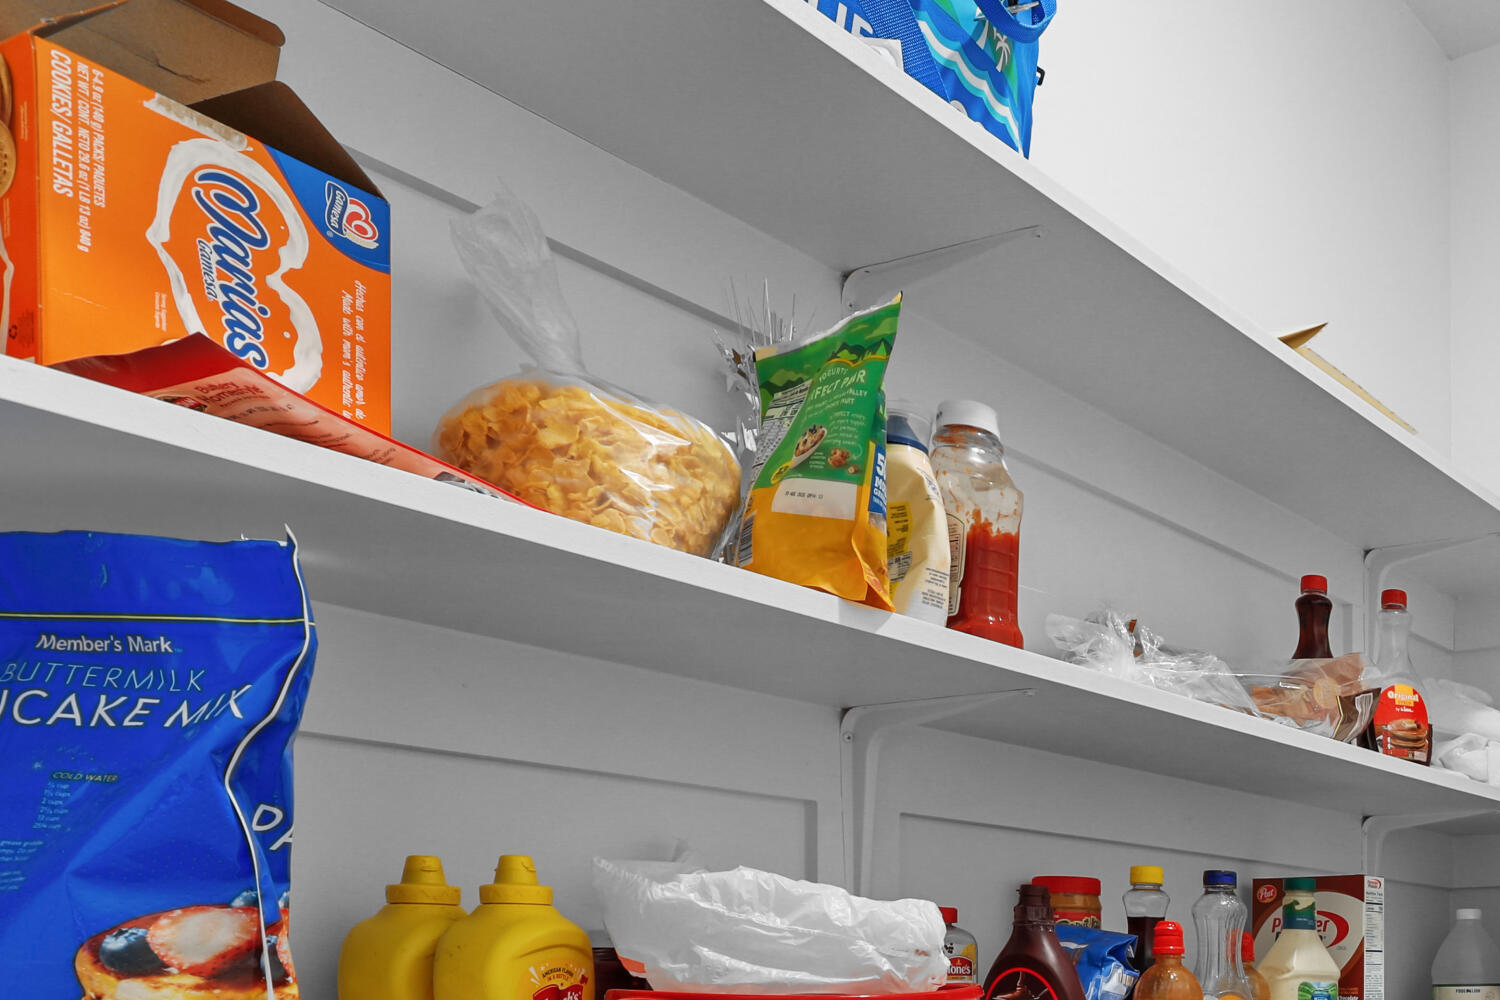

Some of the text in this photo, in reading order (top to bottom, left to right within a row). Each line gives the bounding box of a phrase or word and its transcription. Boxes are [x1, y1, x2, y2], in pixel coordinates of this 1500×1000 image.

[77, 61, 89, 80] NET
[78, 127, 90, 150] NETO
[52, 120, 73, 198] GALLETAS
[342, 317, 353, 336] with
[35, 634, 173, 653] Member's Mark
[0, 662, 205, 692] BUTTERMILK
[1388, 692, 1419, 702] Original
[0, 689, 161, 727] CAKE
